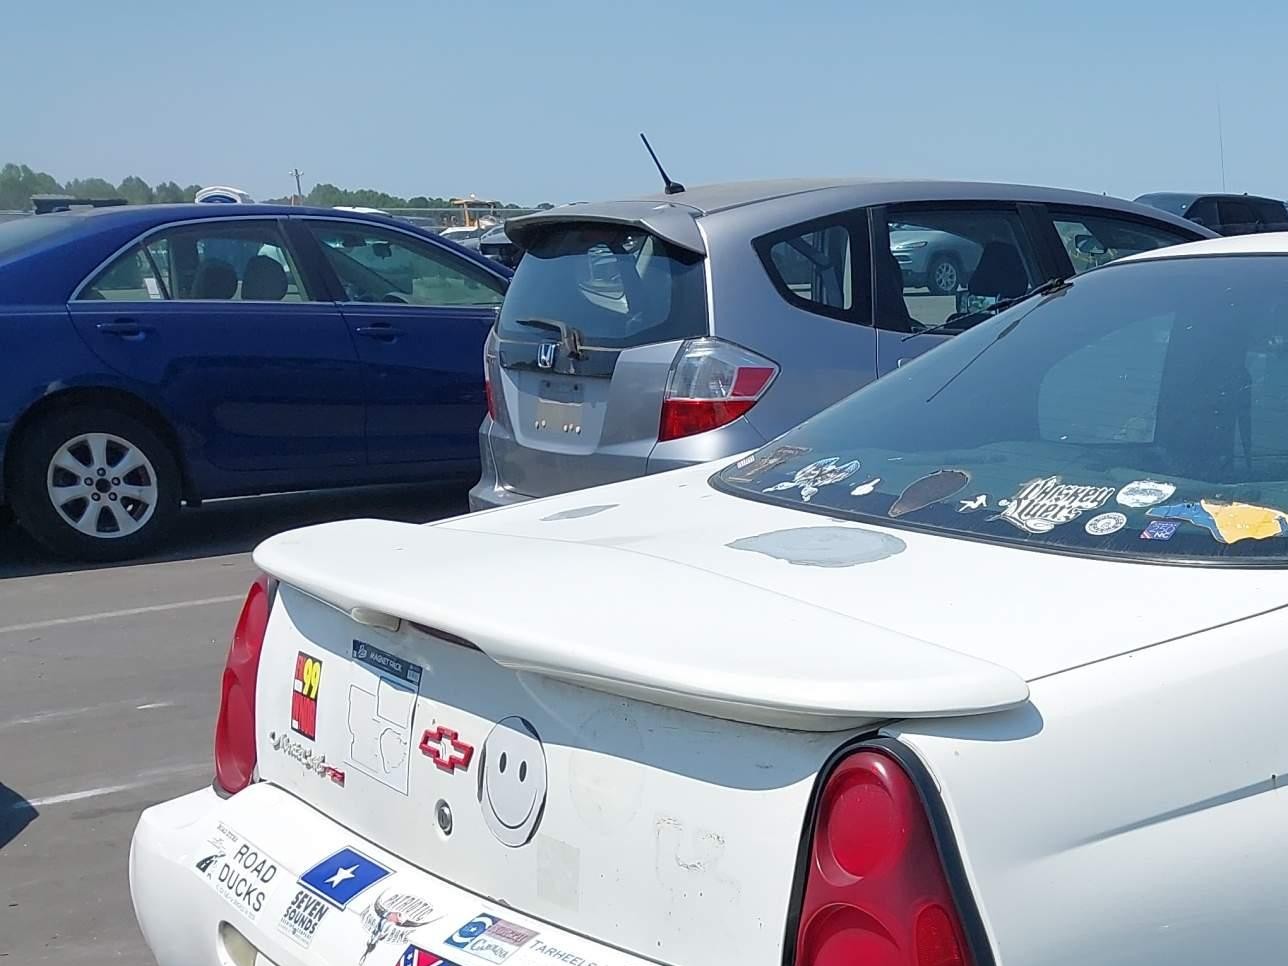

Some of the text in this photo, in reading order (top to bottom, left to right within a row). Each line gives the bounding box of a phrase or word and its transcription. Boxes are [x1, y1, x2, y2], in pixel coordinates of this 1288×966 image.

[233, 844, 277, 883] ROAD
[218, 863, 265, 912] DUCKS
[283, 905, 318, 935] SOUNDS
[291, 890, 329, 922] SEVEN
